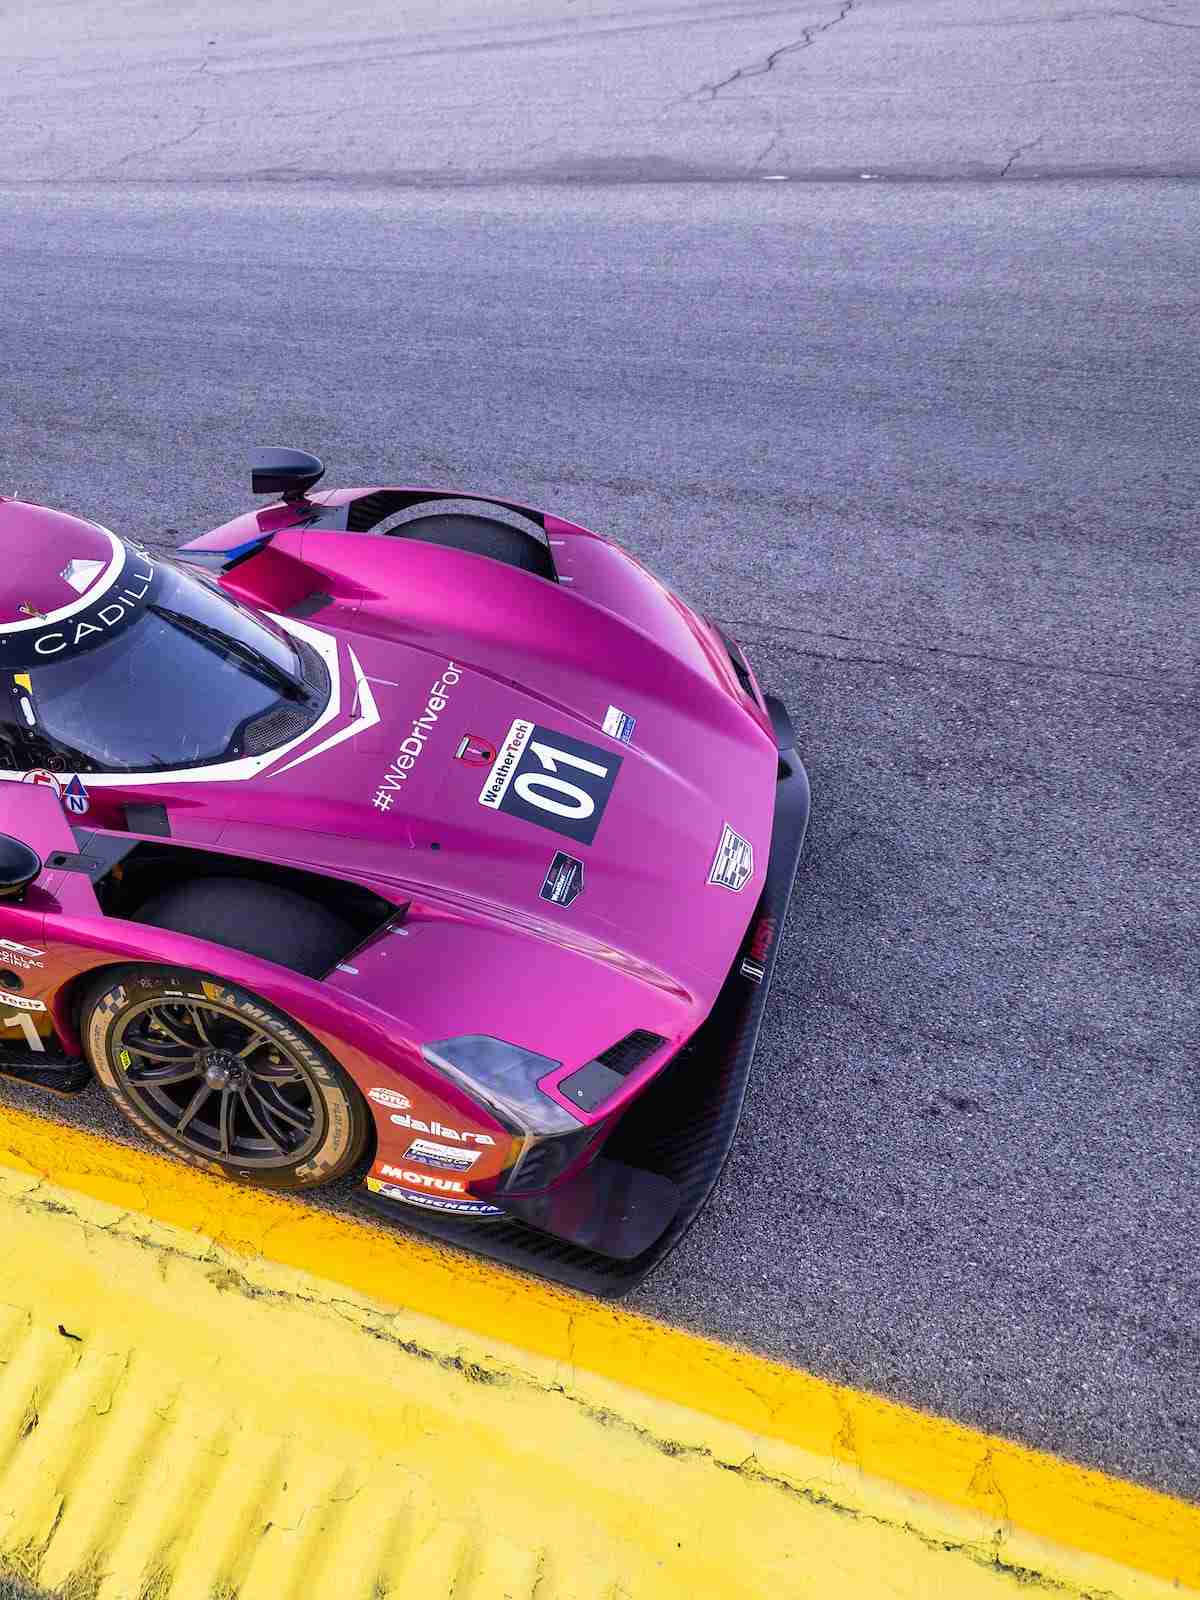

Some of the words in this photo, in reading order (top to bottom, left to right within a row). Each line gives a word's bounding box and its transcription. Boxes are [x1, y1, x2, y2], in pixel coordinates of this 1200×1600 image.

[372, 661, 463, 812] #WeDriveFor
[483, 724, 529, 804] WeatherTech
[70, 797, 84, 811] N
[513, 741, 608, 819] 01
[240, 1002, 333, 1080] MICHELIN
[390, 1113, 497, 1146] dallara
[380, 1164, 465, 1193] MOTUL
[407, 1195, 500, 1212] MICHELIN
